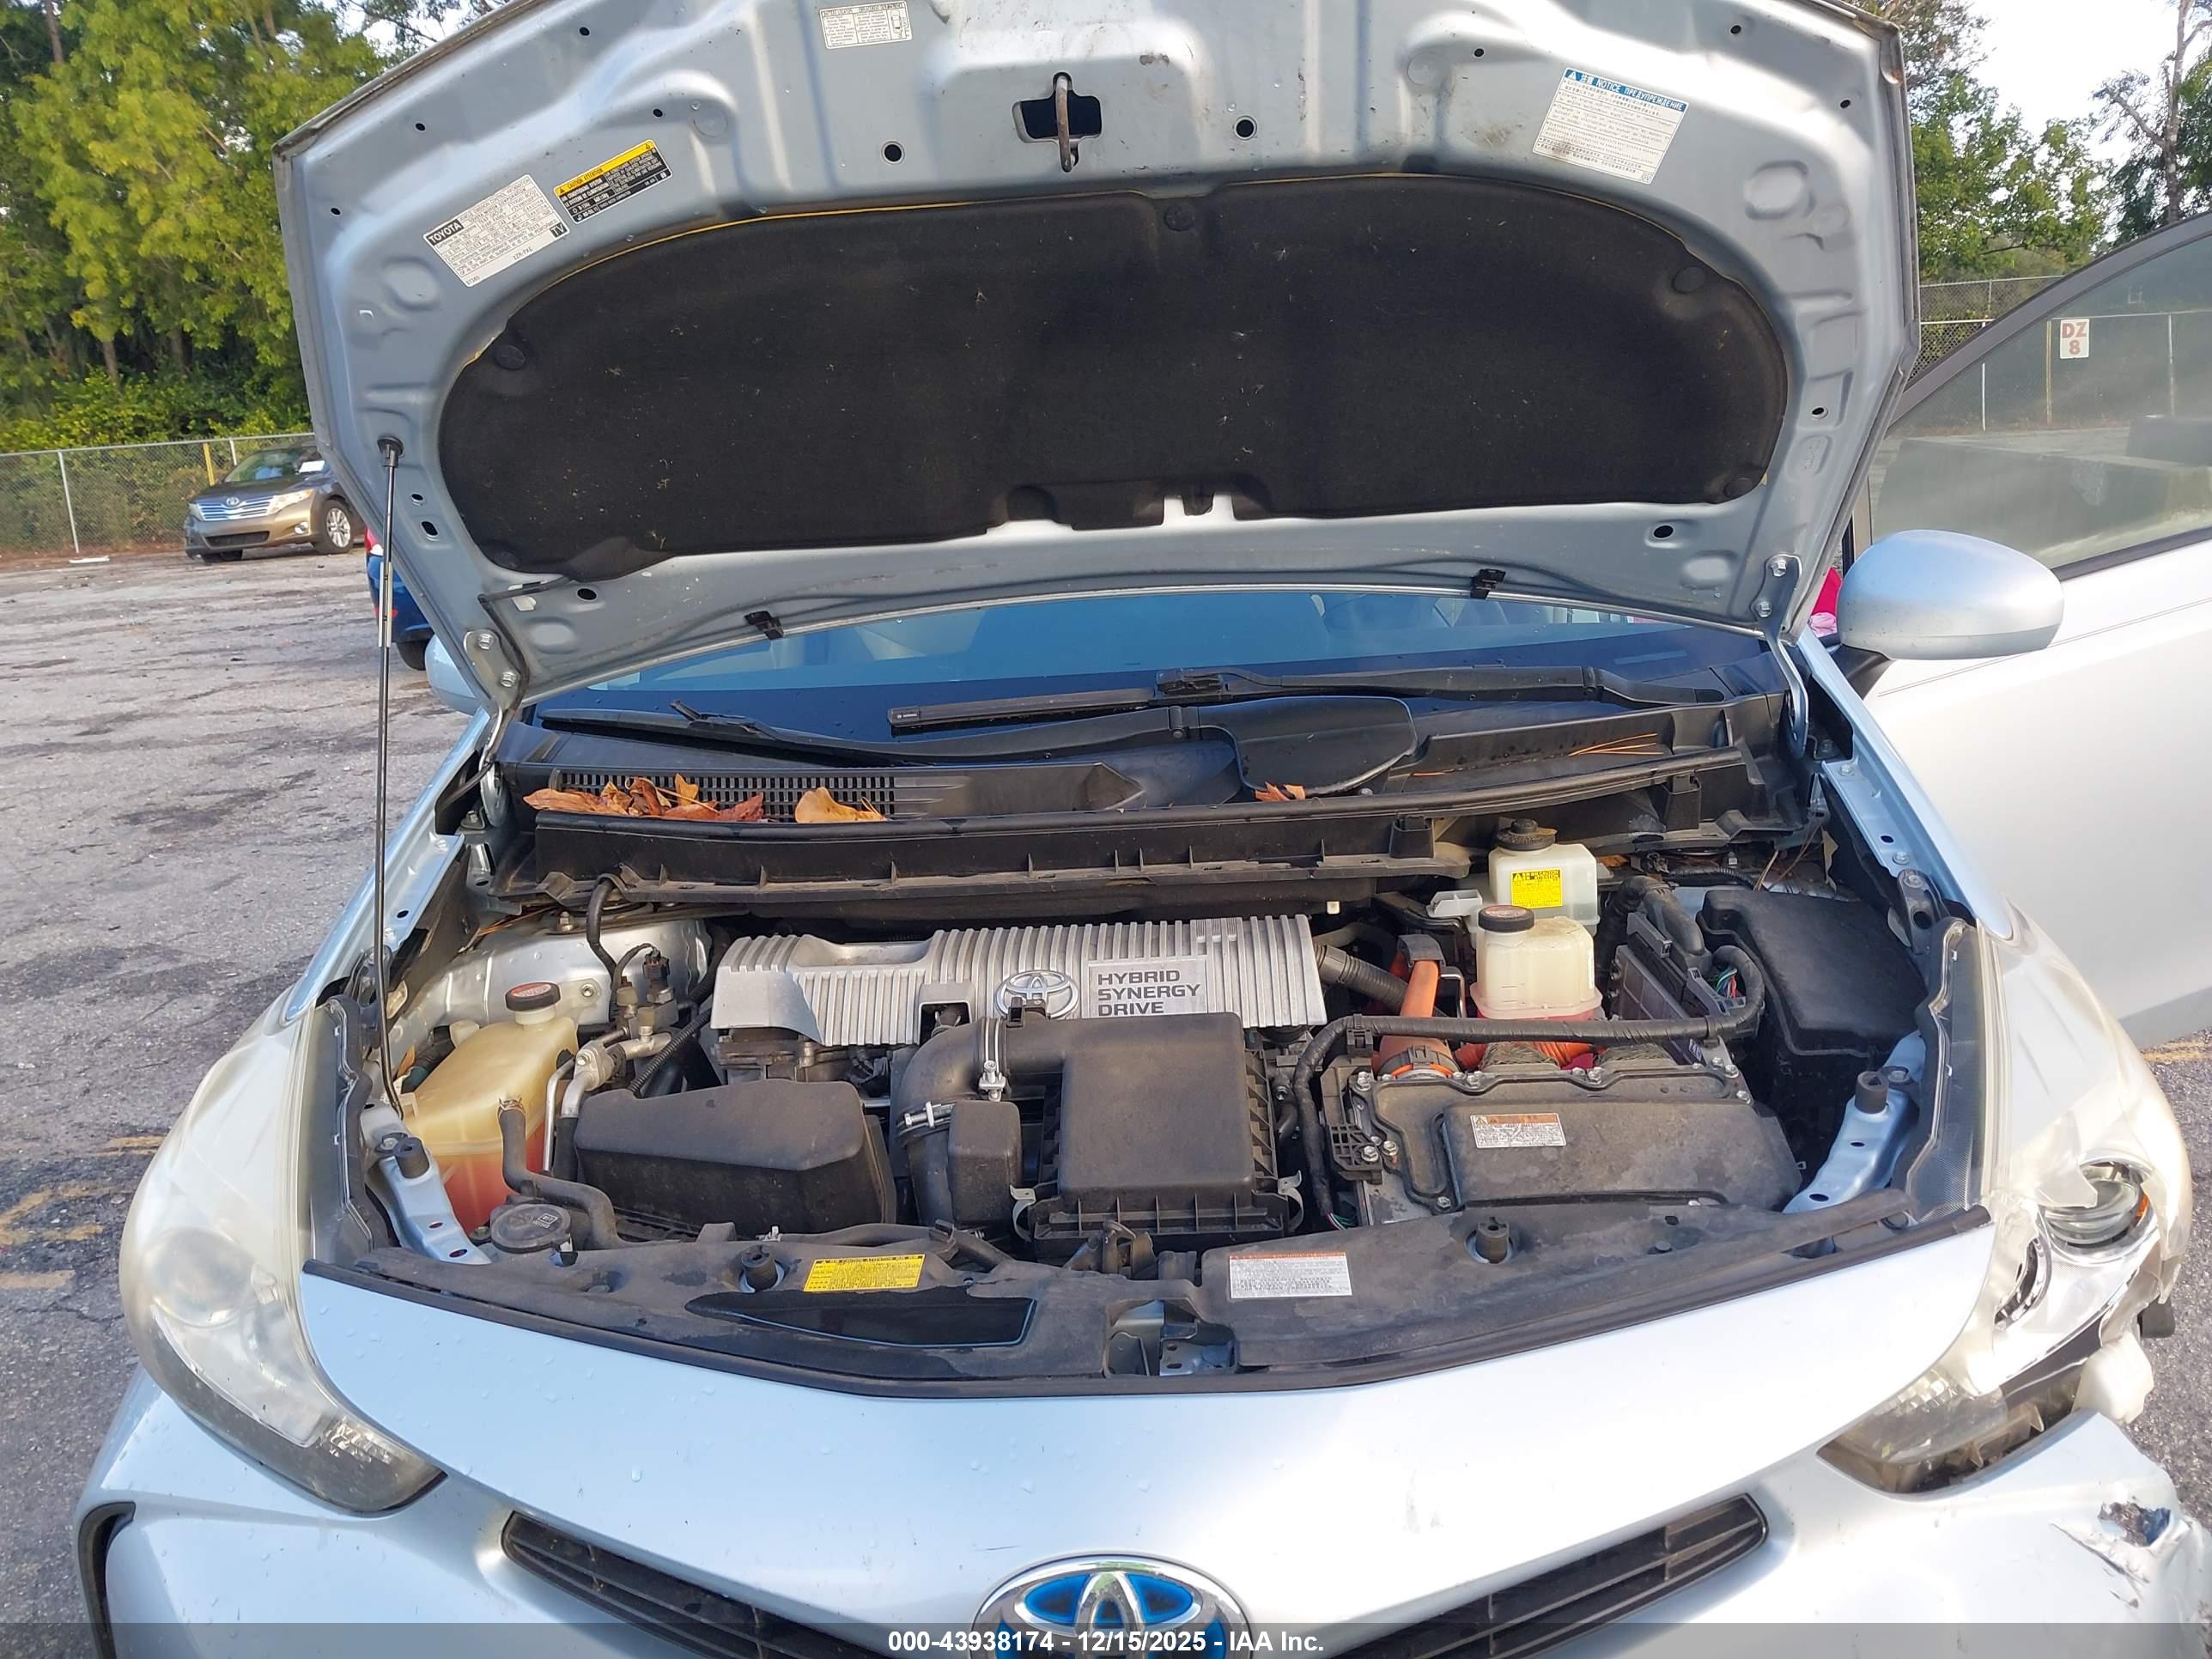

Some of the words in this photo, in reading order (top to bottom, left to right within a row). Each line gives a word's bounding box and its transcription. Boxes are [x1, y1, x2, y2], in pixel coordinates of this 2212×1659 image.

[1596, 80, 1620, 92] NOTICE
[1624, 88, 1683, 110] ПРЕДУПРЕЖДЕНИЕ
[566, 177, 583, 189] CAUTION
[428, 222, 462, 244] TOYOTA
[550, 224, 566, 236] TV
[2062, 322, 2087, 338] DZ
[2069, 340, 2081, 355] 8
[1097, 969, 1181, 985] HYBRID
[1097, 984, 1200, 1001] SYNERGY
[1098, 1002, 1164, 1017] DRIVE
